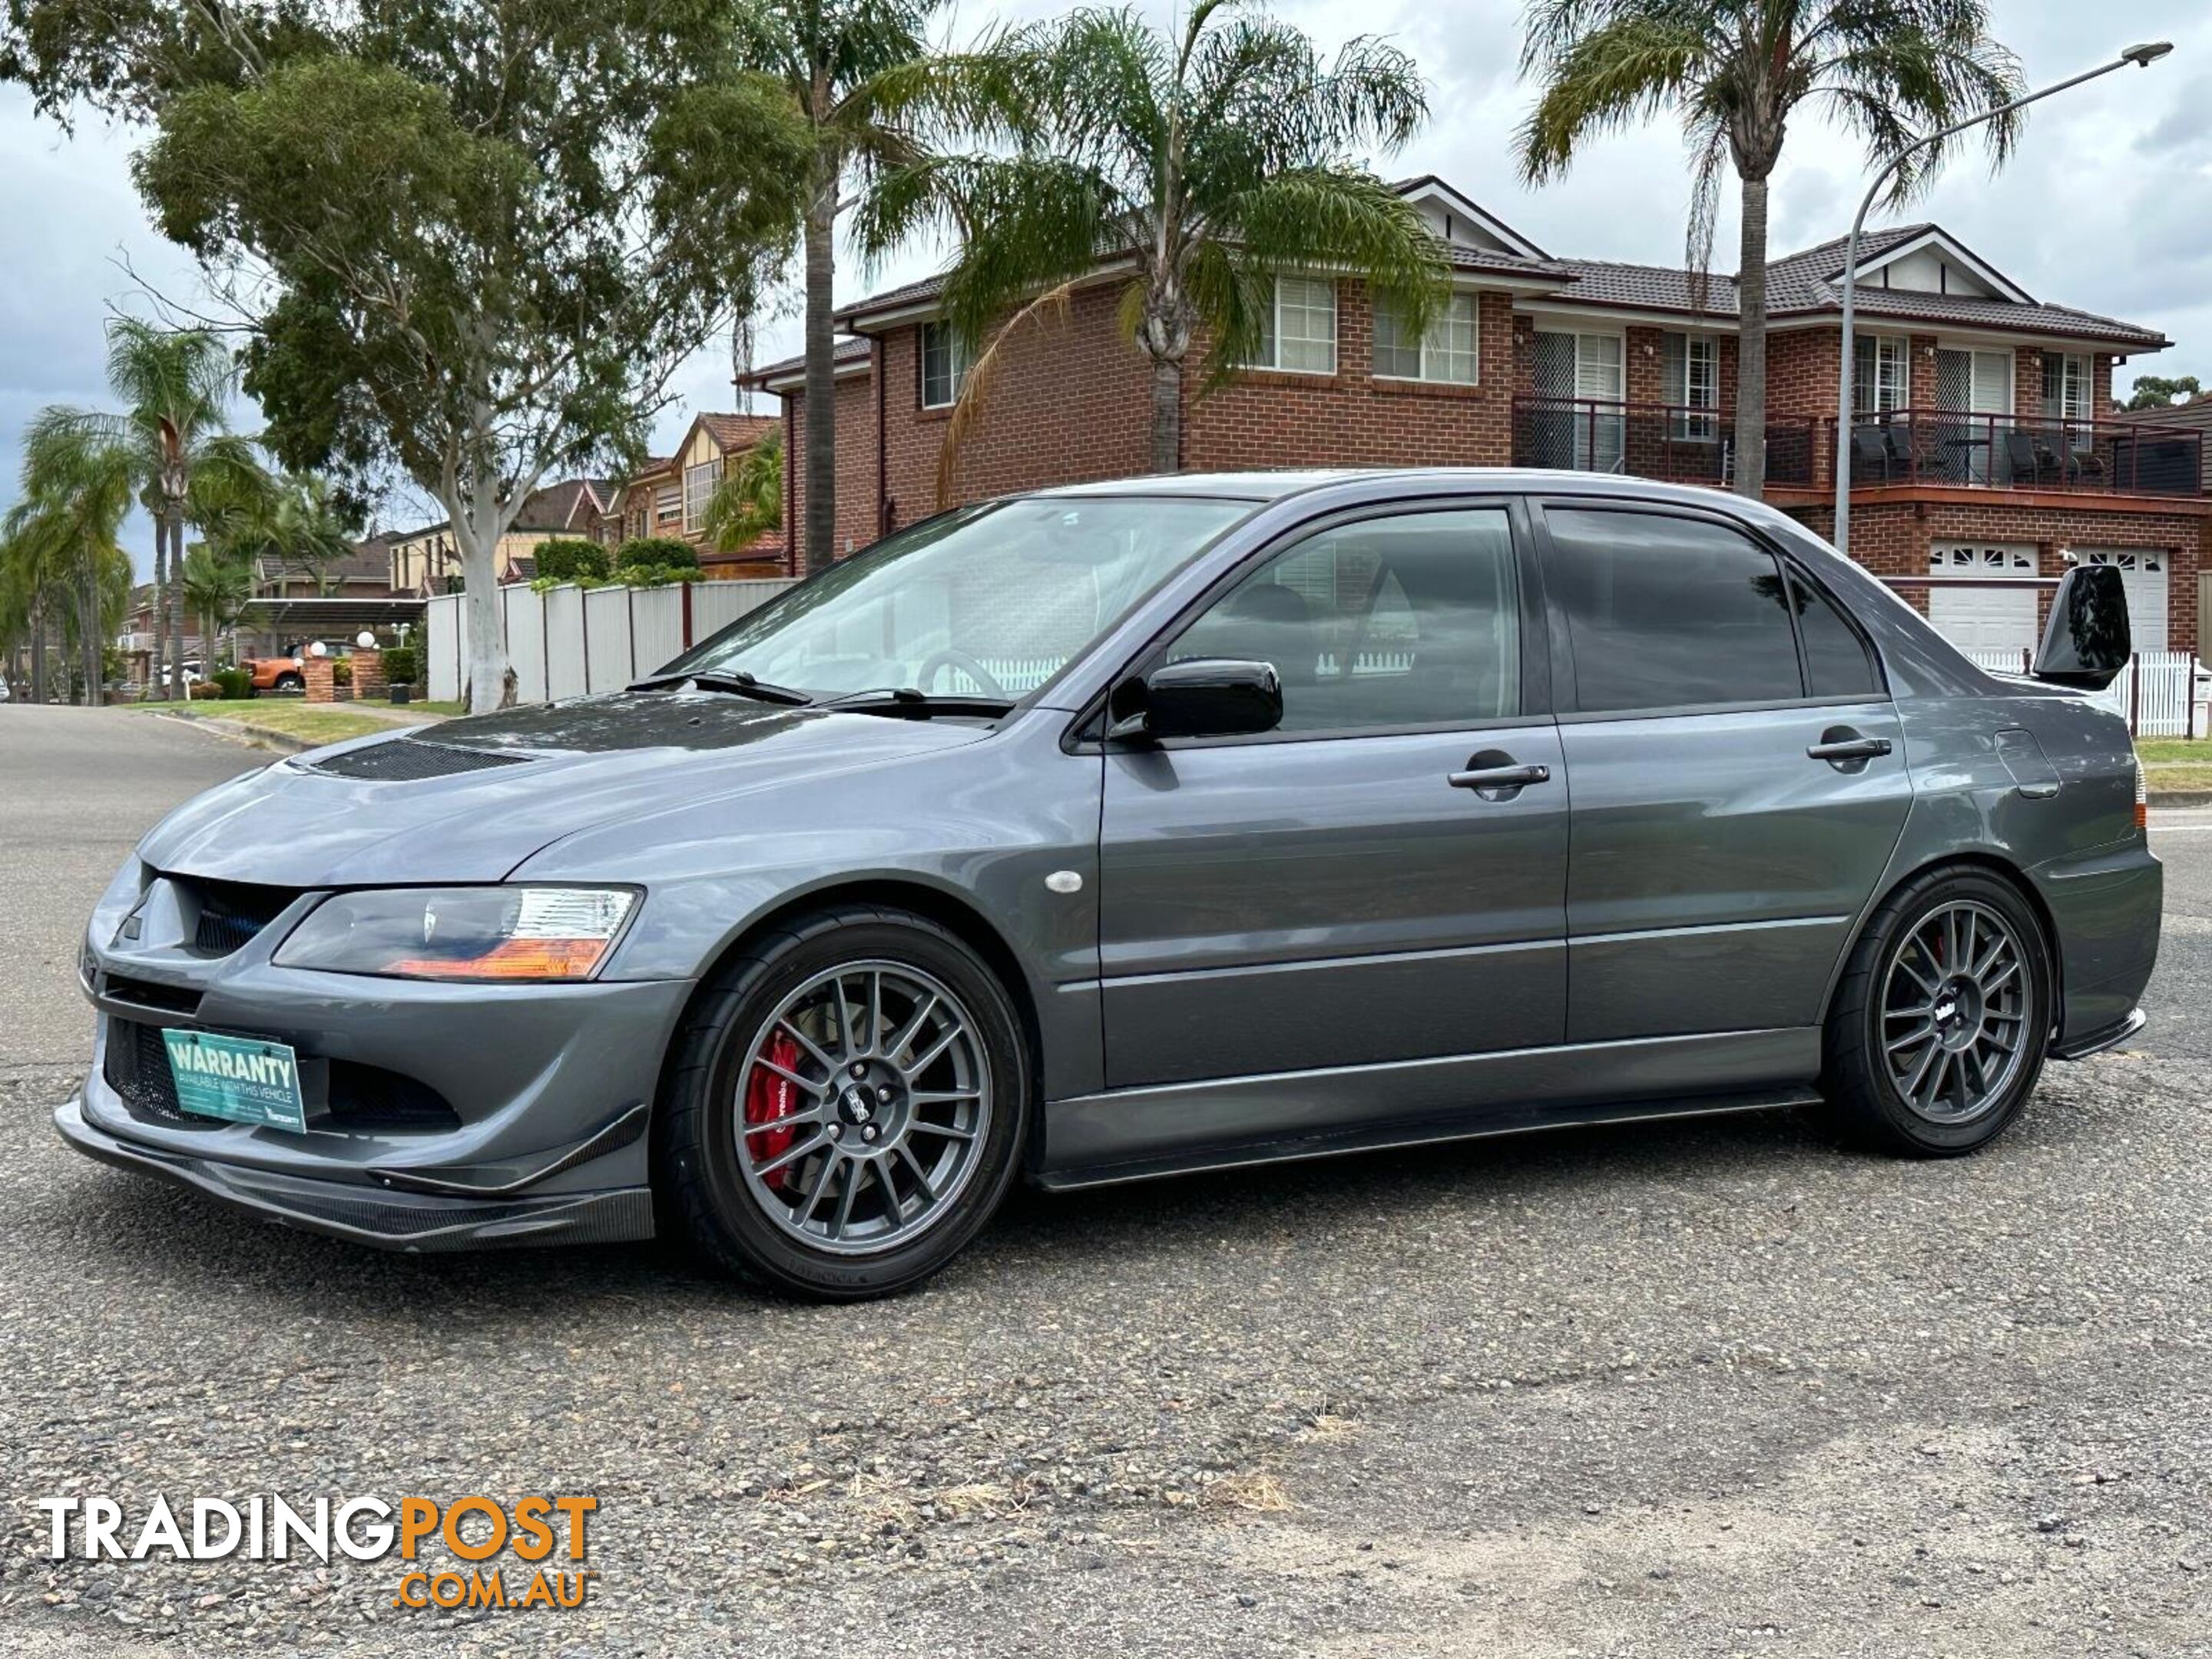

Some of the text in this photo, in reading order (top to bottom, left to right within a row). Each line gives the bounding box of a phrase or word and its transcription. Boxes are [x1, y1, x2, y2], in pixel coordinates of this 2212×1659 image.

[169, 1042, 290, 1088] WARRANTY
[240, 1083, 259, 1097] THIS
[259, 1088, 293, 1104] VEHICLE
